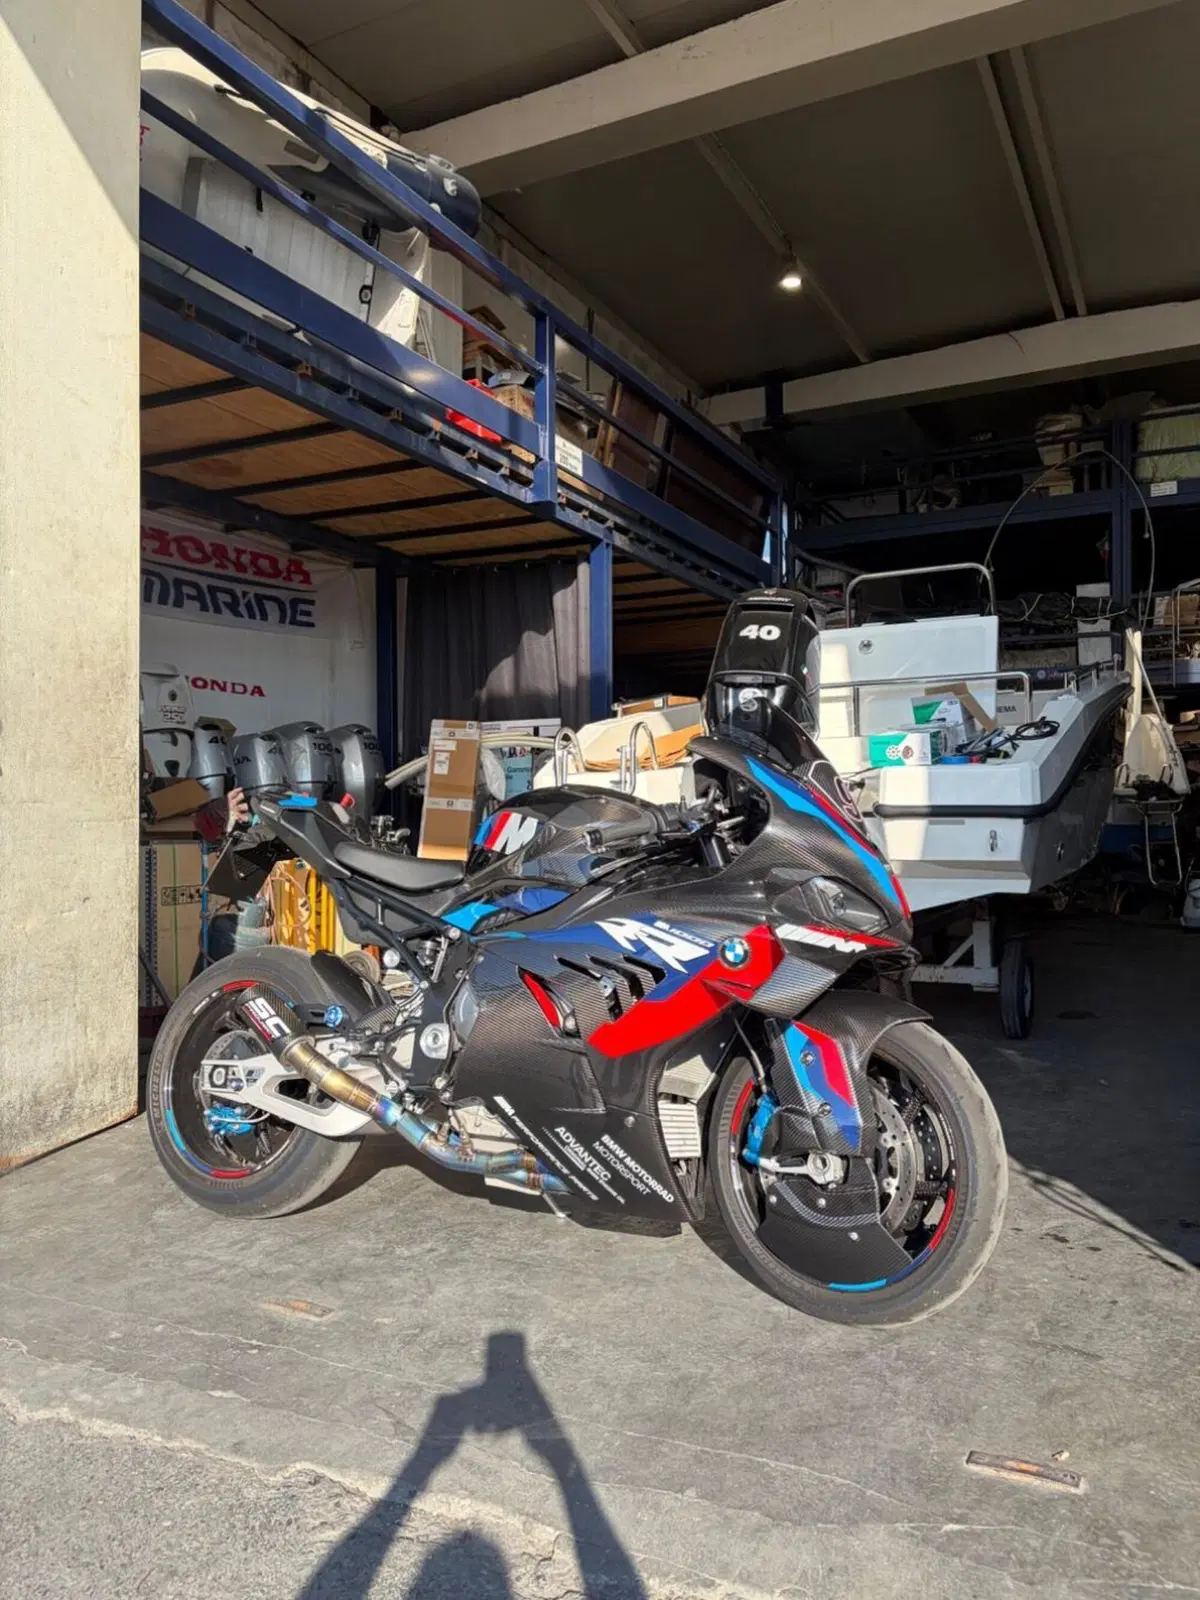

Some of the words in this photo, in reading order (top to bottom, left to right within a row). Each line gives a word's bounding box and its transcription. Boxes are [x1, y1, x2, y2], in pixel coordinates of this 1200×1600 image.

[140, 524, 312, 585] HONDA
[739, 624, 781, 640] 40
[184, 675, 265, 697] ONDA
[554, 1126, 612, 1182] ADVANTEC
[593, 1141, 651, 1196] MOTORSPORT
[601, 1133, 628, 1159] BMW
[624, 1156, 674, 1203] MOTORRAD
